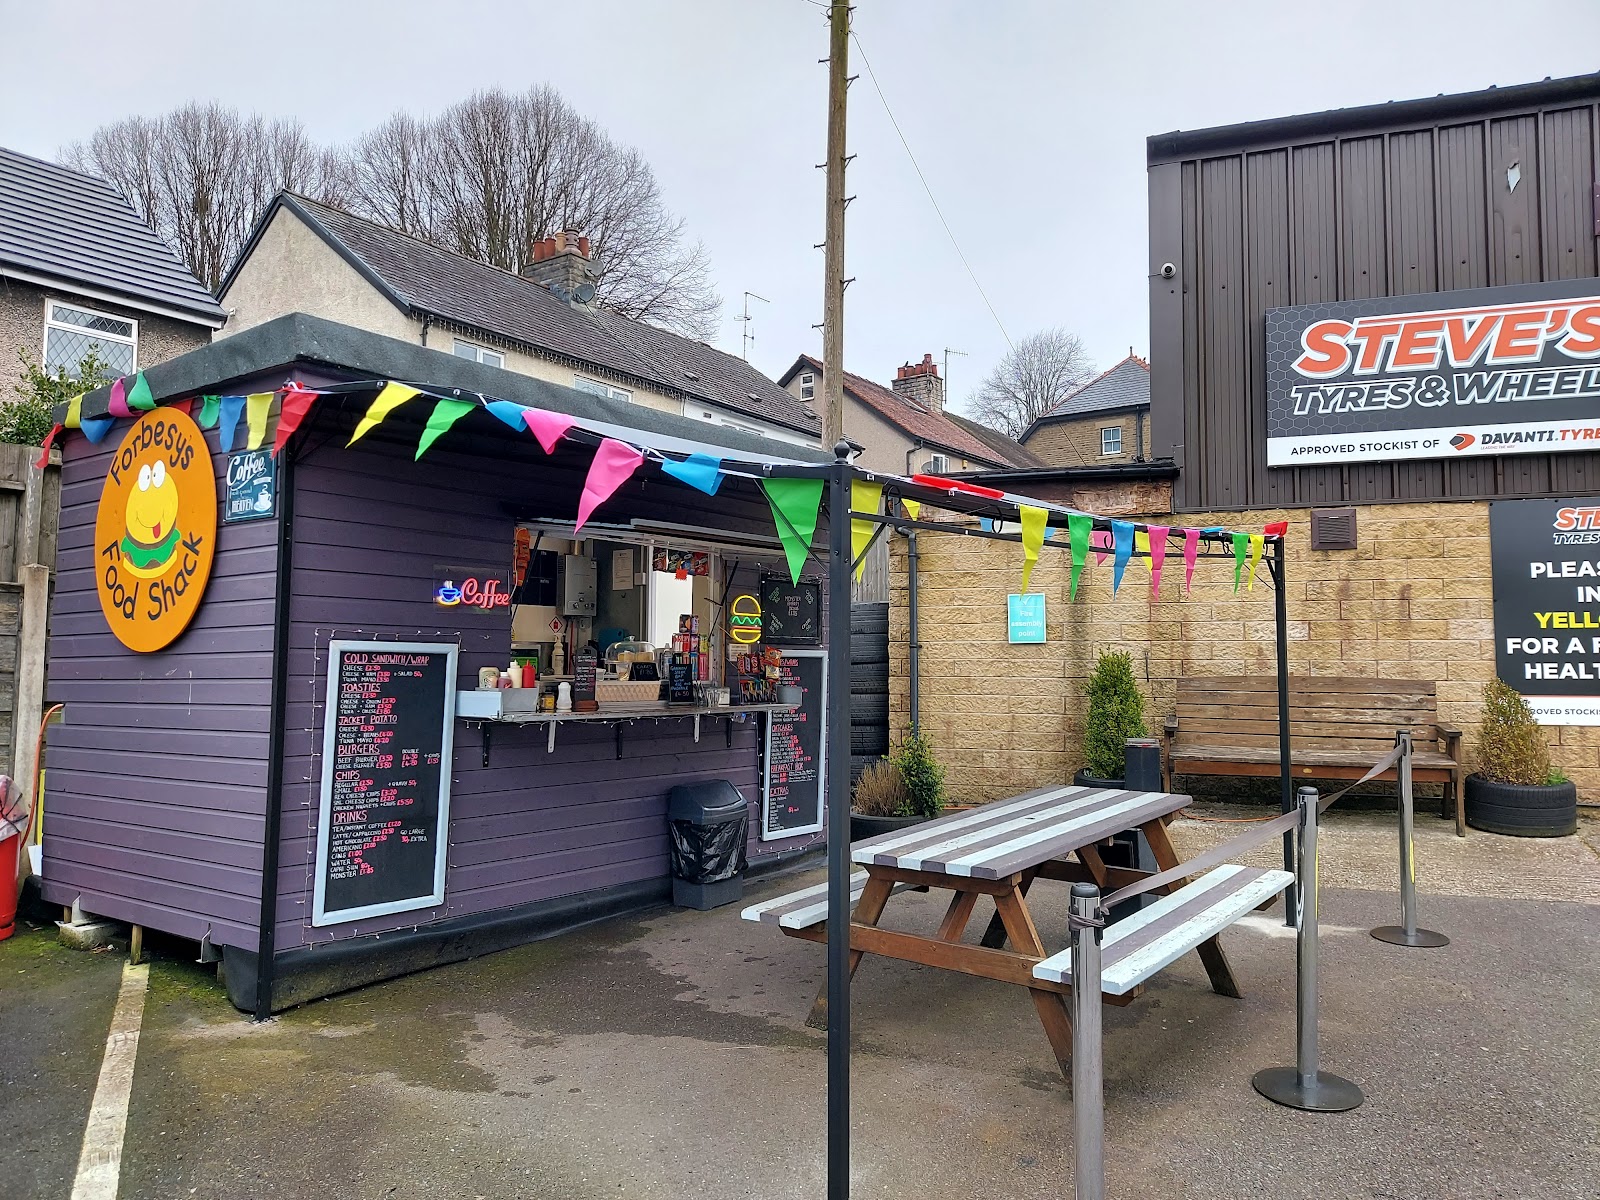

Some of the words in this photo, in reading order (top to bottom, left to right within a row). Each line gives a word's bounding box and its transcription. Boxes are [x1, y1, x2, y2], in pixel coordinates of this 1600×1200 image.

[1291, 305, 1600, 379] STEVE'S
[1291, 379, 1415, 415] TYRES
[1291, 444, 1356, 456] APPROVED
[1359, 441, 1418, 452] STOCKIST
[1423, 439, 1440, 449] OF
[227, 452, 266, 488] Coffee
[102, 540, 140, 621] Food
[147, 532, 203, 621] Shack
[1530, 561, 1600, 579] PLEA
[461, 577, 510, 609] Coffee
[1011, 620, 1043, 628] assembly
[1533, 611, 1600, 629] YELL
[1506, 637, 1560, 655] FOR
[1566, 637, 1586, 654] A
[344, 653, 368, 664] COLD
[371, 654, 430, 666] SANDWICH/WRAP
[341, 683, 381, 691] TOASTIES
[1565, 708, 1600, 716] STOCKI
[339, 716, 365, 724] JACKET
[370, 715, 397, 723] POTATO
[338, 744, 380, 754] BURGERS
[336, 770, 360, 780] CHIPS
[334, 810, 367, 823] DRINKS
[332, 844, 363, 853] AMERICANO
[331, 859, 351, 867] WATER
[330, 870, 357, 880] MONSTER
